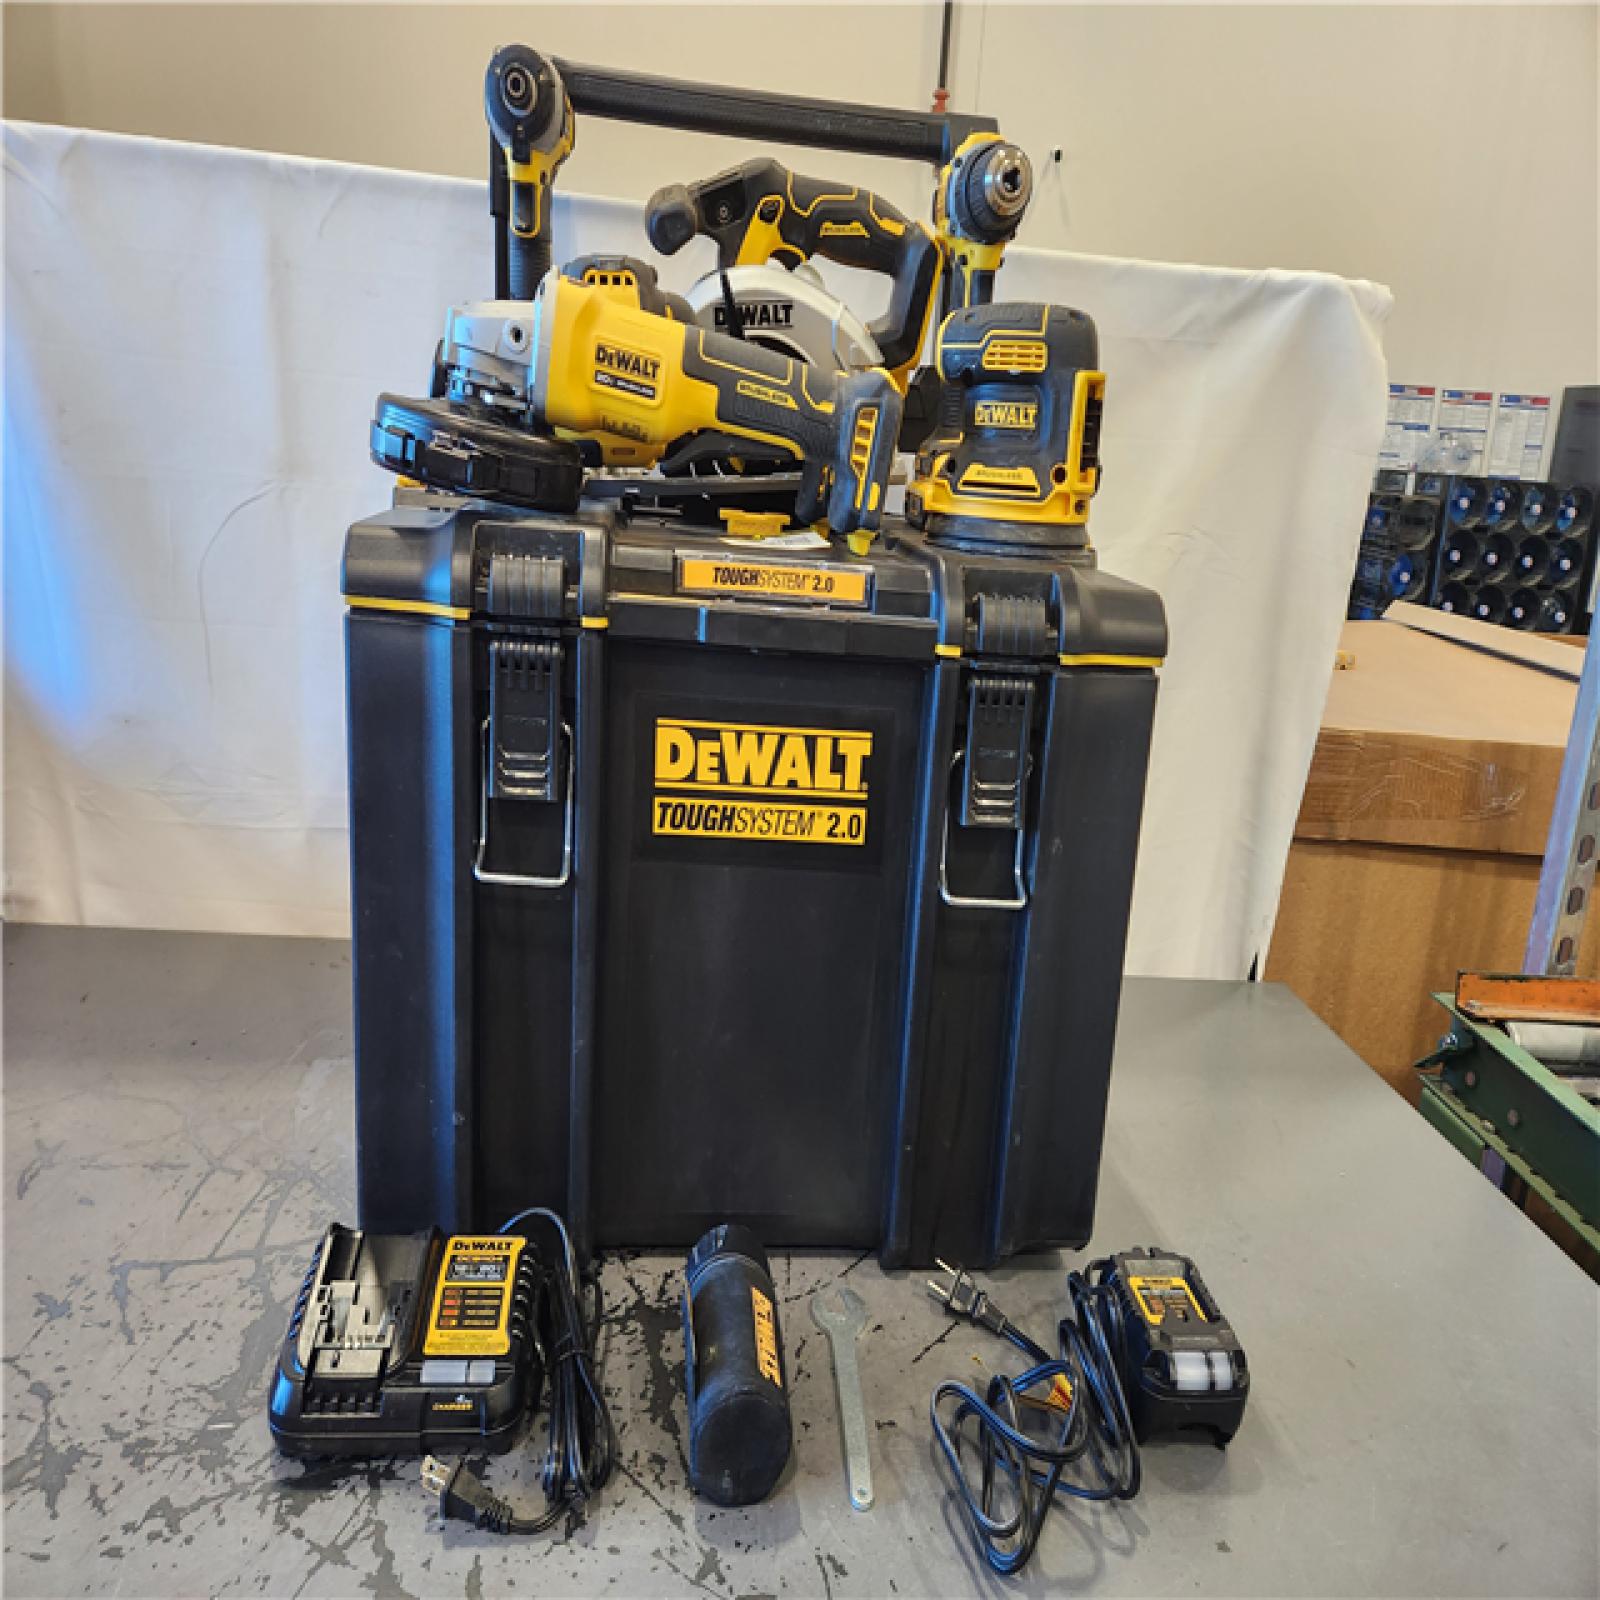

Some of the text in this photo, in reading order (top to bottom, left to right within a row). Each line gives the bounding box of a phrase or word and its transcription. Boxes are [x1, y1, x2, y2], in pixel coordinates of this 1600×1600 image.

[812, 575, 834, 593] 2.0
[657, 802, 861, 839] TOUGHSYSTEM 2.0
